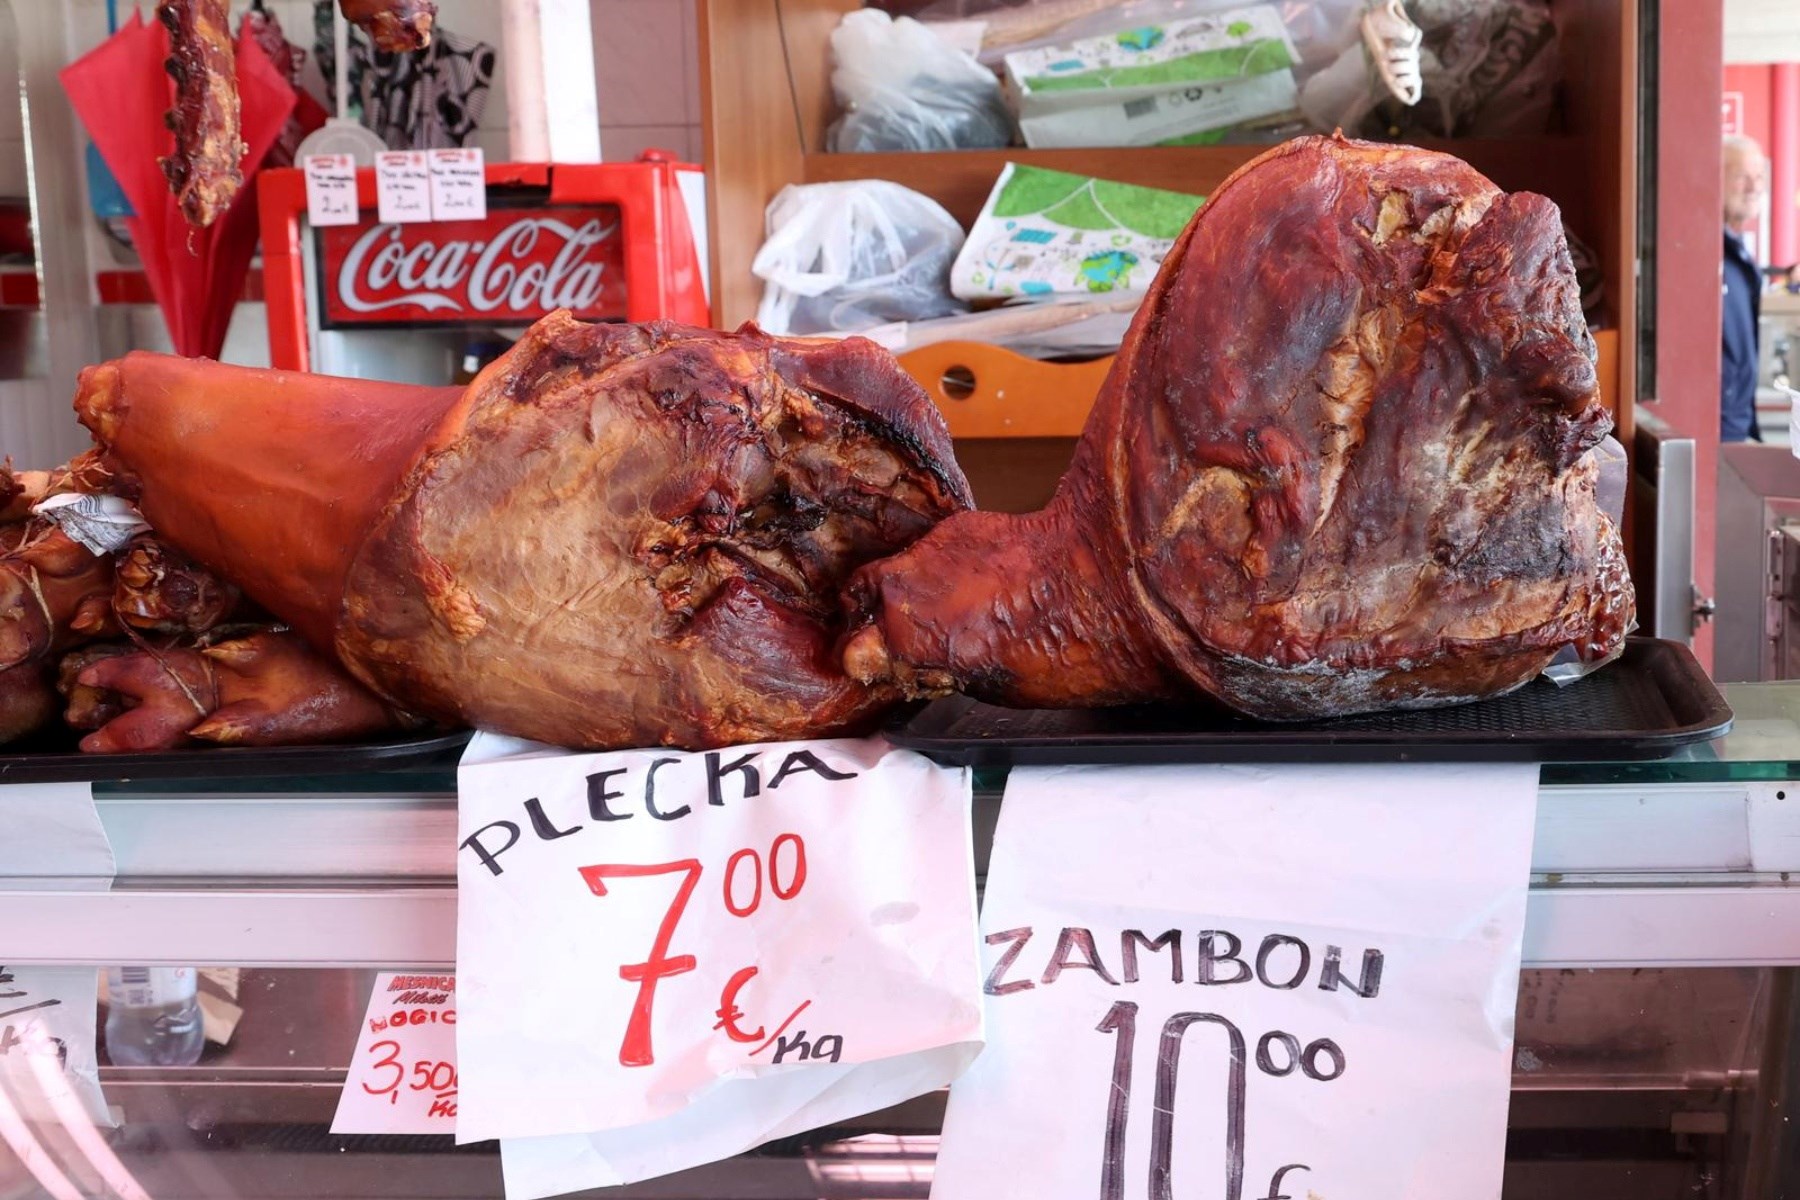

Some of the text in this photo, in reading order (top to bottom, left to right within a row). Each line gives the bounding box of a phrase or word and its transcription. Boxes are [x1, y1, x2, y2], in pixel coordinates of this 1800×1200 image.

[338, 218, 617, 312] Coca-Cola
[459, 751, 859, 877] PLECKA
[983, 927, 1385, 998] ZAMBON
